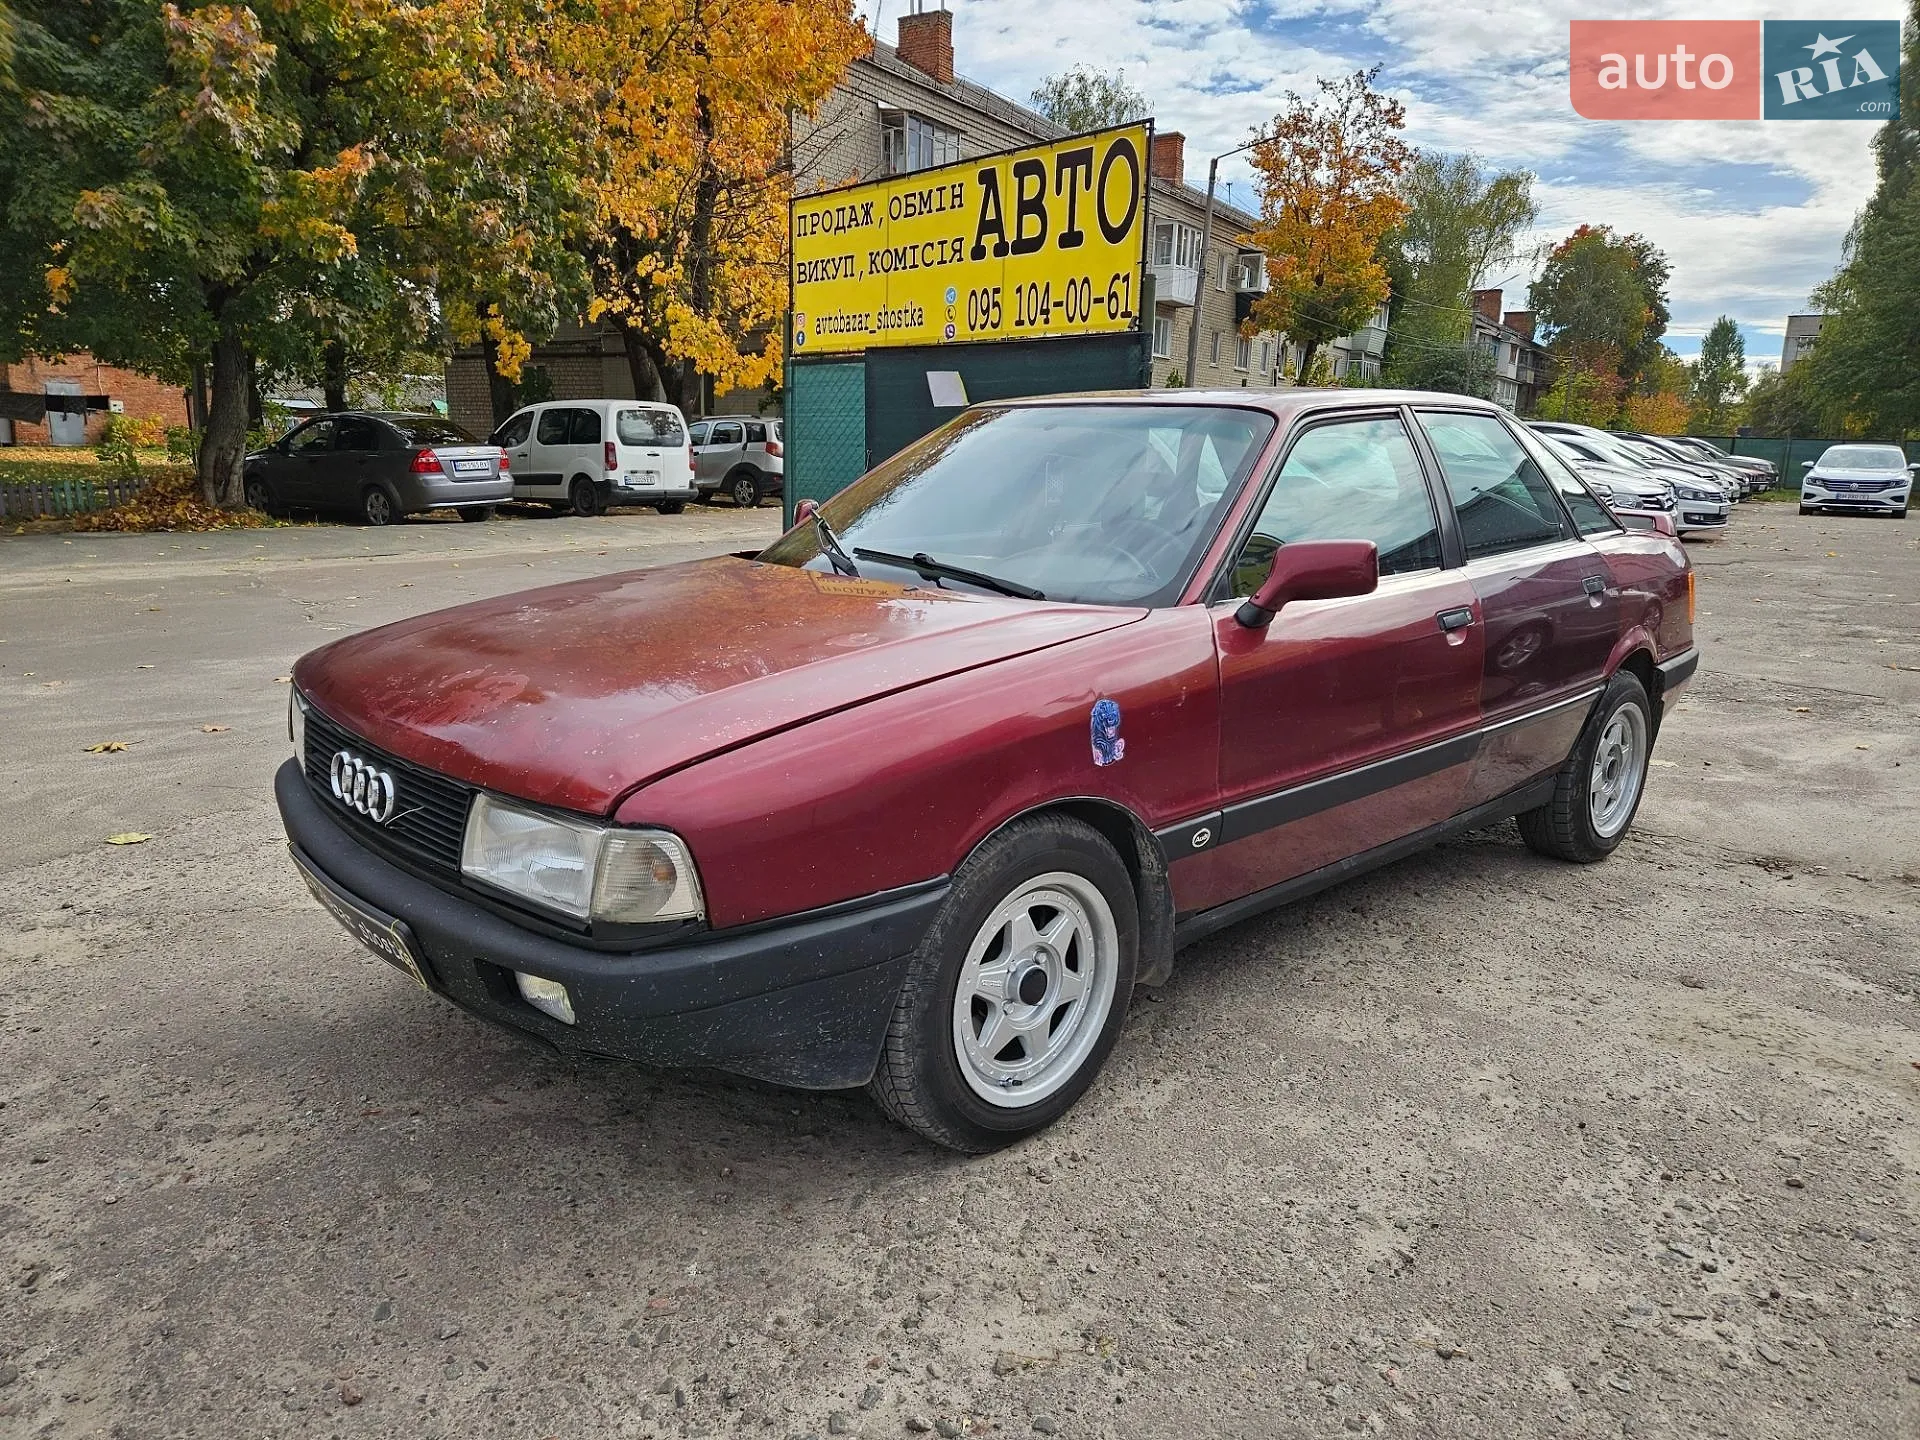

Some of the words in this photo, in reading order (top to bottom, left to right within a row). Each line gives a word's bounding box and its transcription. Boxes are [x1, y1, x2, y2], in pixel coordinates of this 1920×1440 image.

[970, 137, 1140, 261] АВТО
[815, 301, 924, 336] avtobazar_shostka
[968, 286, 1001, 332] 095
[1014, 272, 1133, 327] 104-00-61
